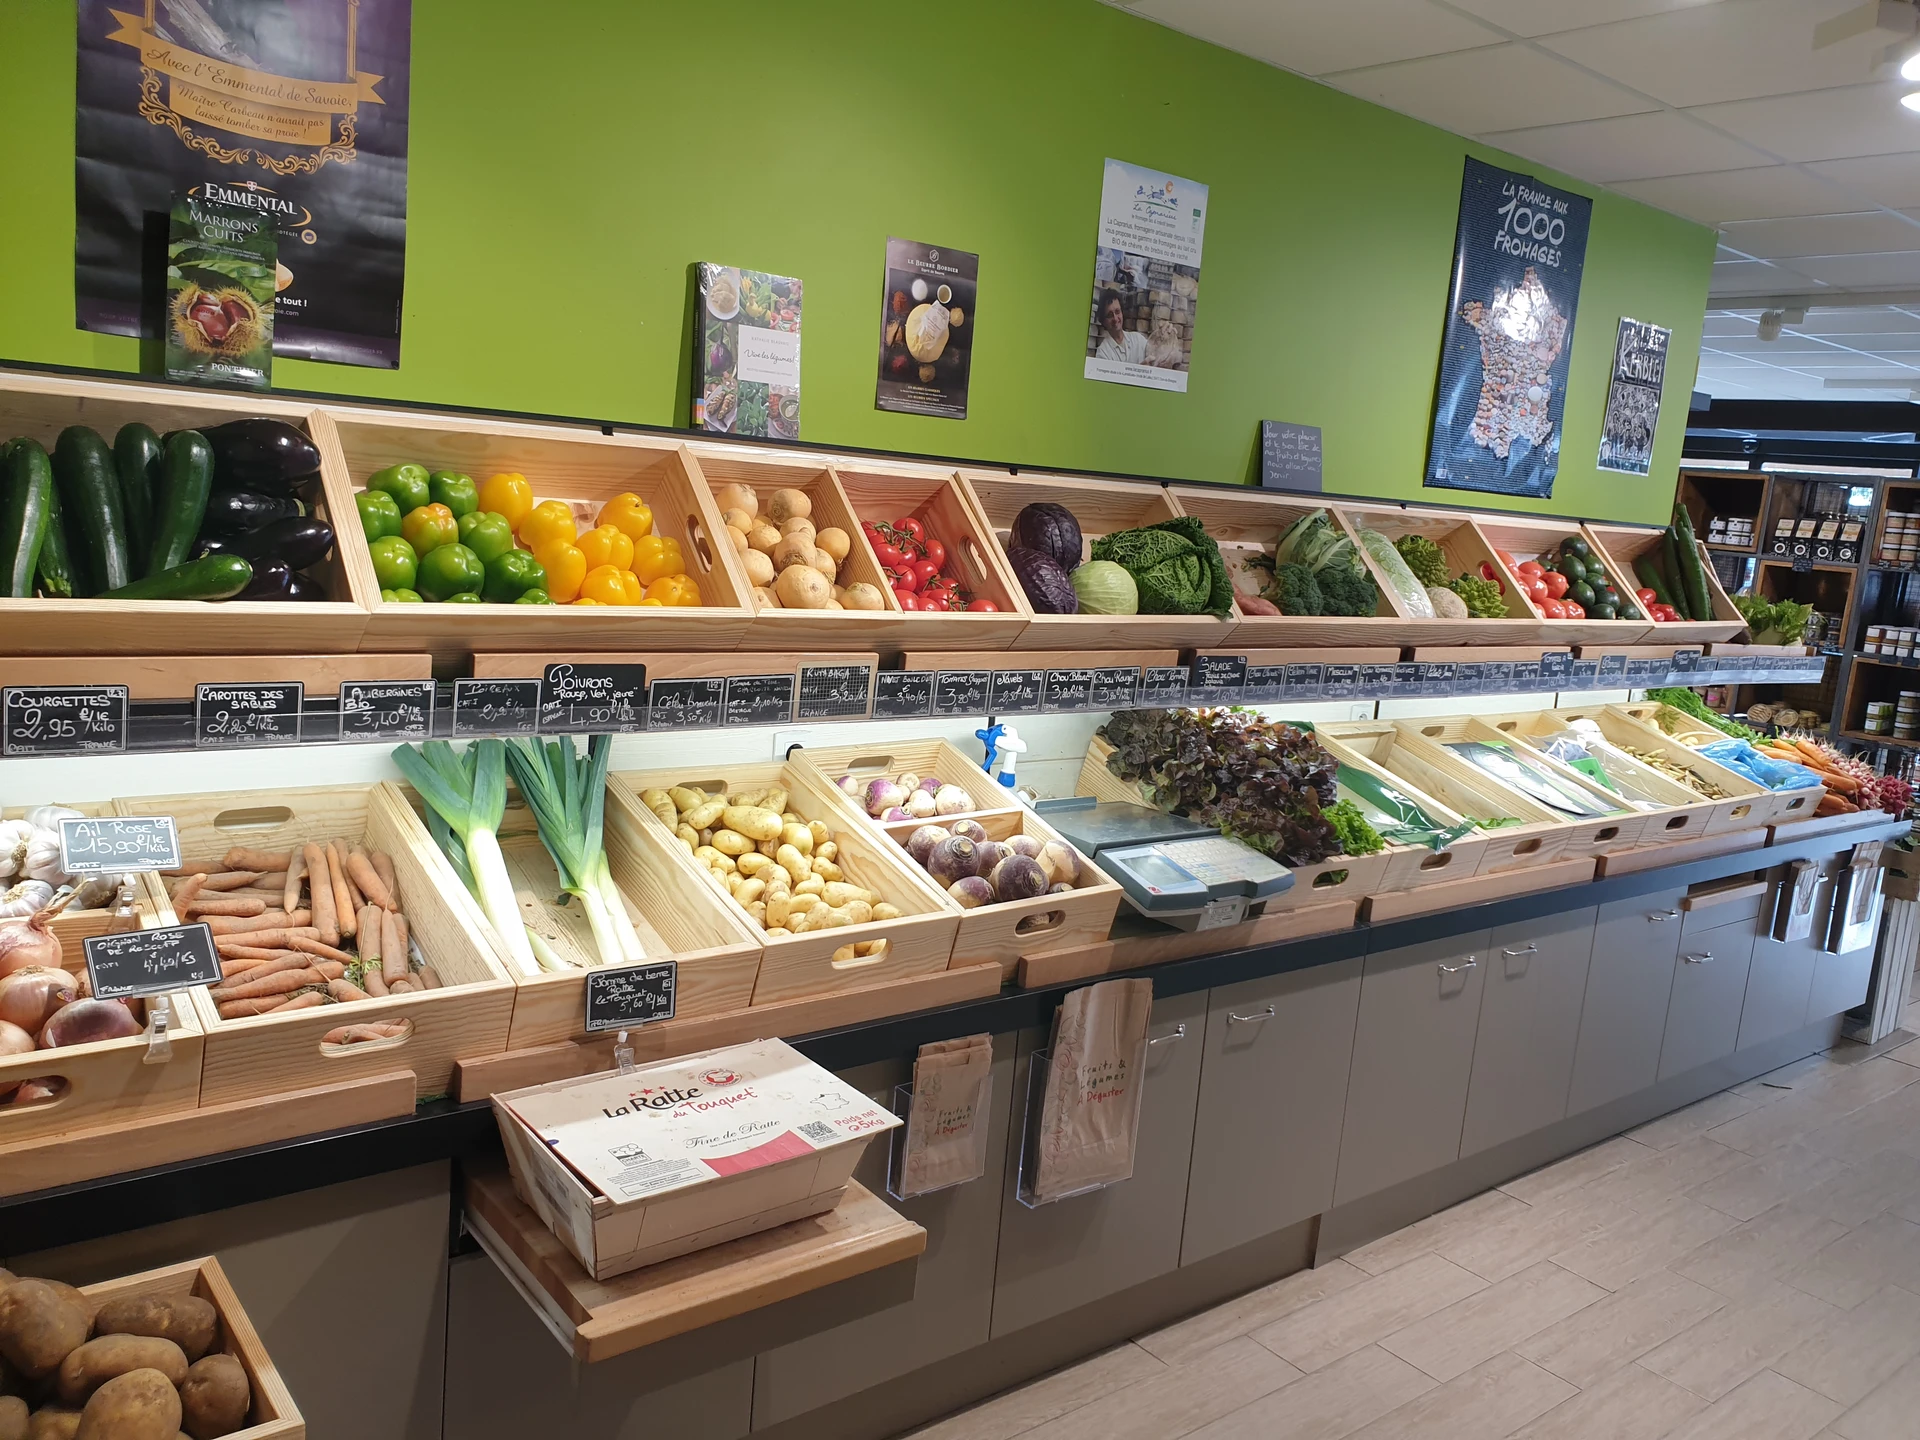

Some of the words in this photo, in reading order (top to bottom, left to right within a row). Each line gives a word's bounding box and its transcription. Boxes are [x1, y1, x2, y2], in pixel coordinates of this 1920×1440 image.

[147, 49, 191, 73] Avec
[194, 62, 284, 99] l'Emmental
[287, 86, 300, 102] de
[304, 87, 352, 107] Savoie.
[194, 105, 224, 122] laissé
[226, 119, 261, 132] tomber
[275, 129, 300, 139] proie
[219, 100, 264, 120] Corbeau
[307, 119, 325, 130] pas
[204, 182, 298, 216] EMMENTAL
[1502, 181, 1516, 198] LA
[1517, 185, 1552, 209] FRANCE
[1552, 199, 1569, 215] AUX
[189, 209, 259, 234] MARRONS
[1107, 217, 1113, 225] La
[1497, 197, 1566, 246] 1000
[203, 225, 244, 243] CUITS
[1105, 227, 1115, 235] vous
[1115, 229, 1132, 239] propose
[1158, 238, 1177, 250] fromages
[1111, 236, 1121, 245] BIO
[1121, 238, 1127, 247] de
[1170, 250, 1176, 258] de
[1494, 229, 1562, 268] FROMAGES
[915, 259, 936, 269] BEURRE
[936, 263, 959, 273] BORDIER
[283, 296, 302, 306] tout
[743, 349, 760, 358] Vive
[761, 351, 769, 360] les
[1264, 421, 1279, 438] Pour
[1281, 429, 1297, 439] votre
[1267, 460, 1284, 468] nous
[1275, 449, 1293, 463] fruits
[1198, 657, 1234, 673] SALADE
[1093, 672, 1114, 685] Chou
[1113, 669, 1135, 685] Rouge
[1147, 669, 1166, 683] Chou
[199, 686, 257, 701] CAROTTES
[260, 690, 285, 700] DES
[230, 700, 278, 710] SABLES
[800, 708, 829, 717] FRANCE
[74, 823, 102, 838] Ail
[151, 931, 185, 942] ROSE
[590, 974, 627, 988] Pomme
[629, 972, 644, 982] de
[1082, 1059, 1113, 1077] Fruits
[1118, 1058, 1127, 1069] &
[1080, 1072, 1125, 1090] Légumes
[602, 1107, 630, 1119] La
[629, 1087, 704, 1112] Ratte
[678, 1088, 758, 1113] Touquet
[673, 1110, 689, 1119] du
[834, 1113, 863, 1127] Poids
[861, 1109, 878, 1119] net
[939, 1105, 963, 1118] Fruits
[683, 1135, 720, 1149] Fine
[722, 1130, 738, 1140] de
[738, 1120, 781, 1134] Ratte
